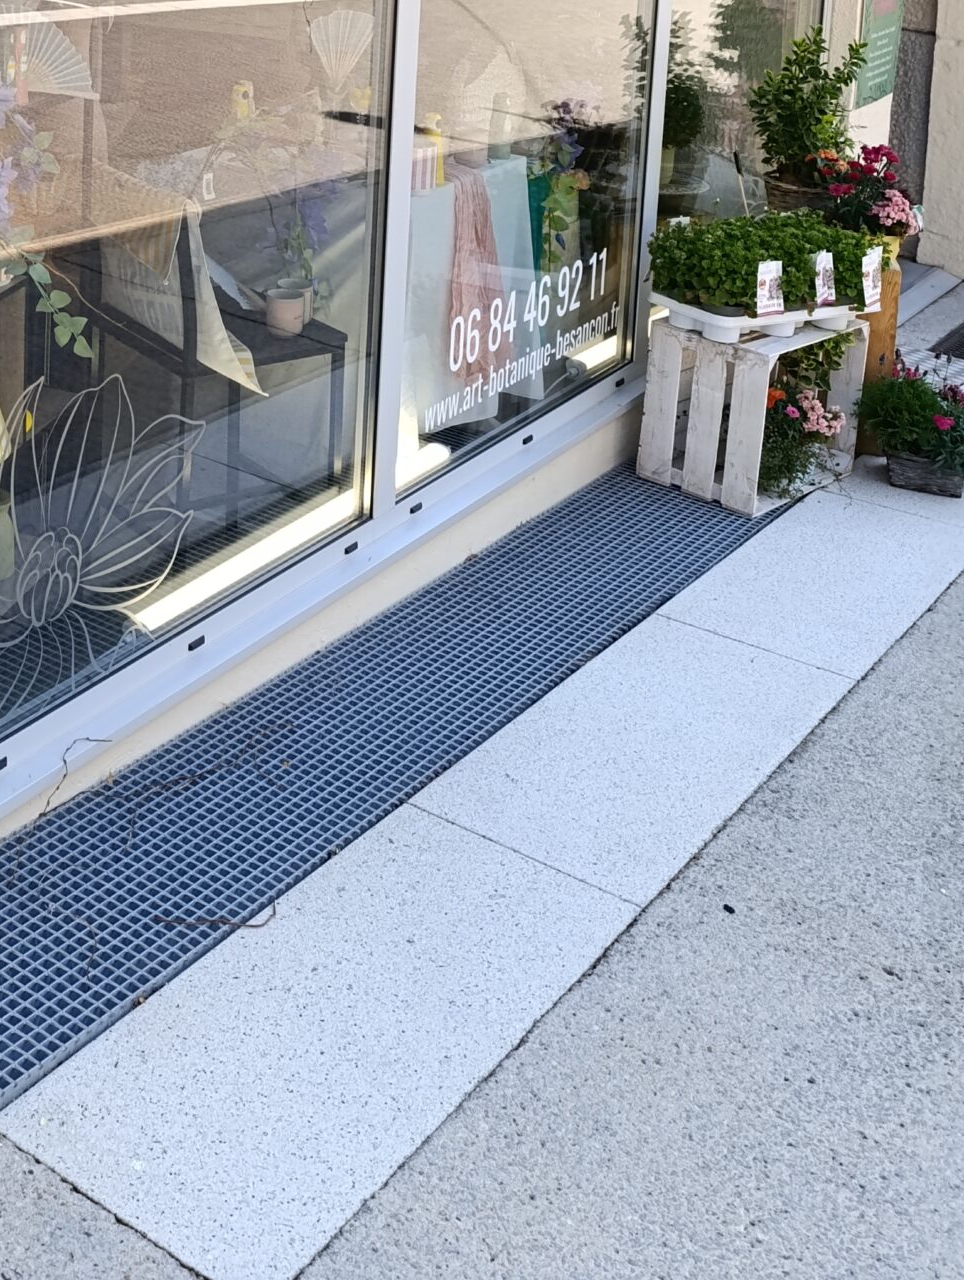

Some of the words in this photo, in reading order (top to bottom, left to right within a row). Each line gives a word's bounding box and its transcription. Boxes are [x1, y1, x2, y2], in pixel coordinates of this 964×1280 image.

[424, 301, 620, 432] www.art-botanique-besancon.fr
[449, 308, 481, 372] 06
[488, 290, 517, 353] 84
[523, 274, 551, 332] 46
[556, 259, 583, 317] 92
[588, 247, 608, 301] 11
